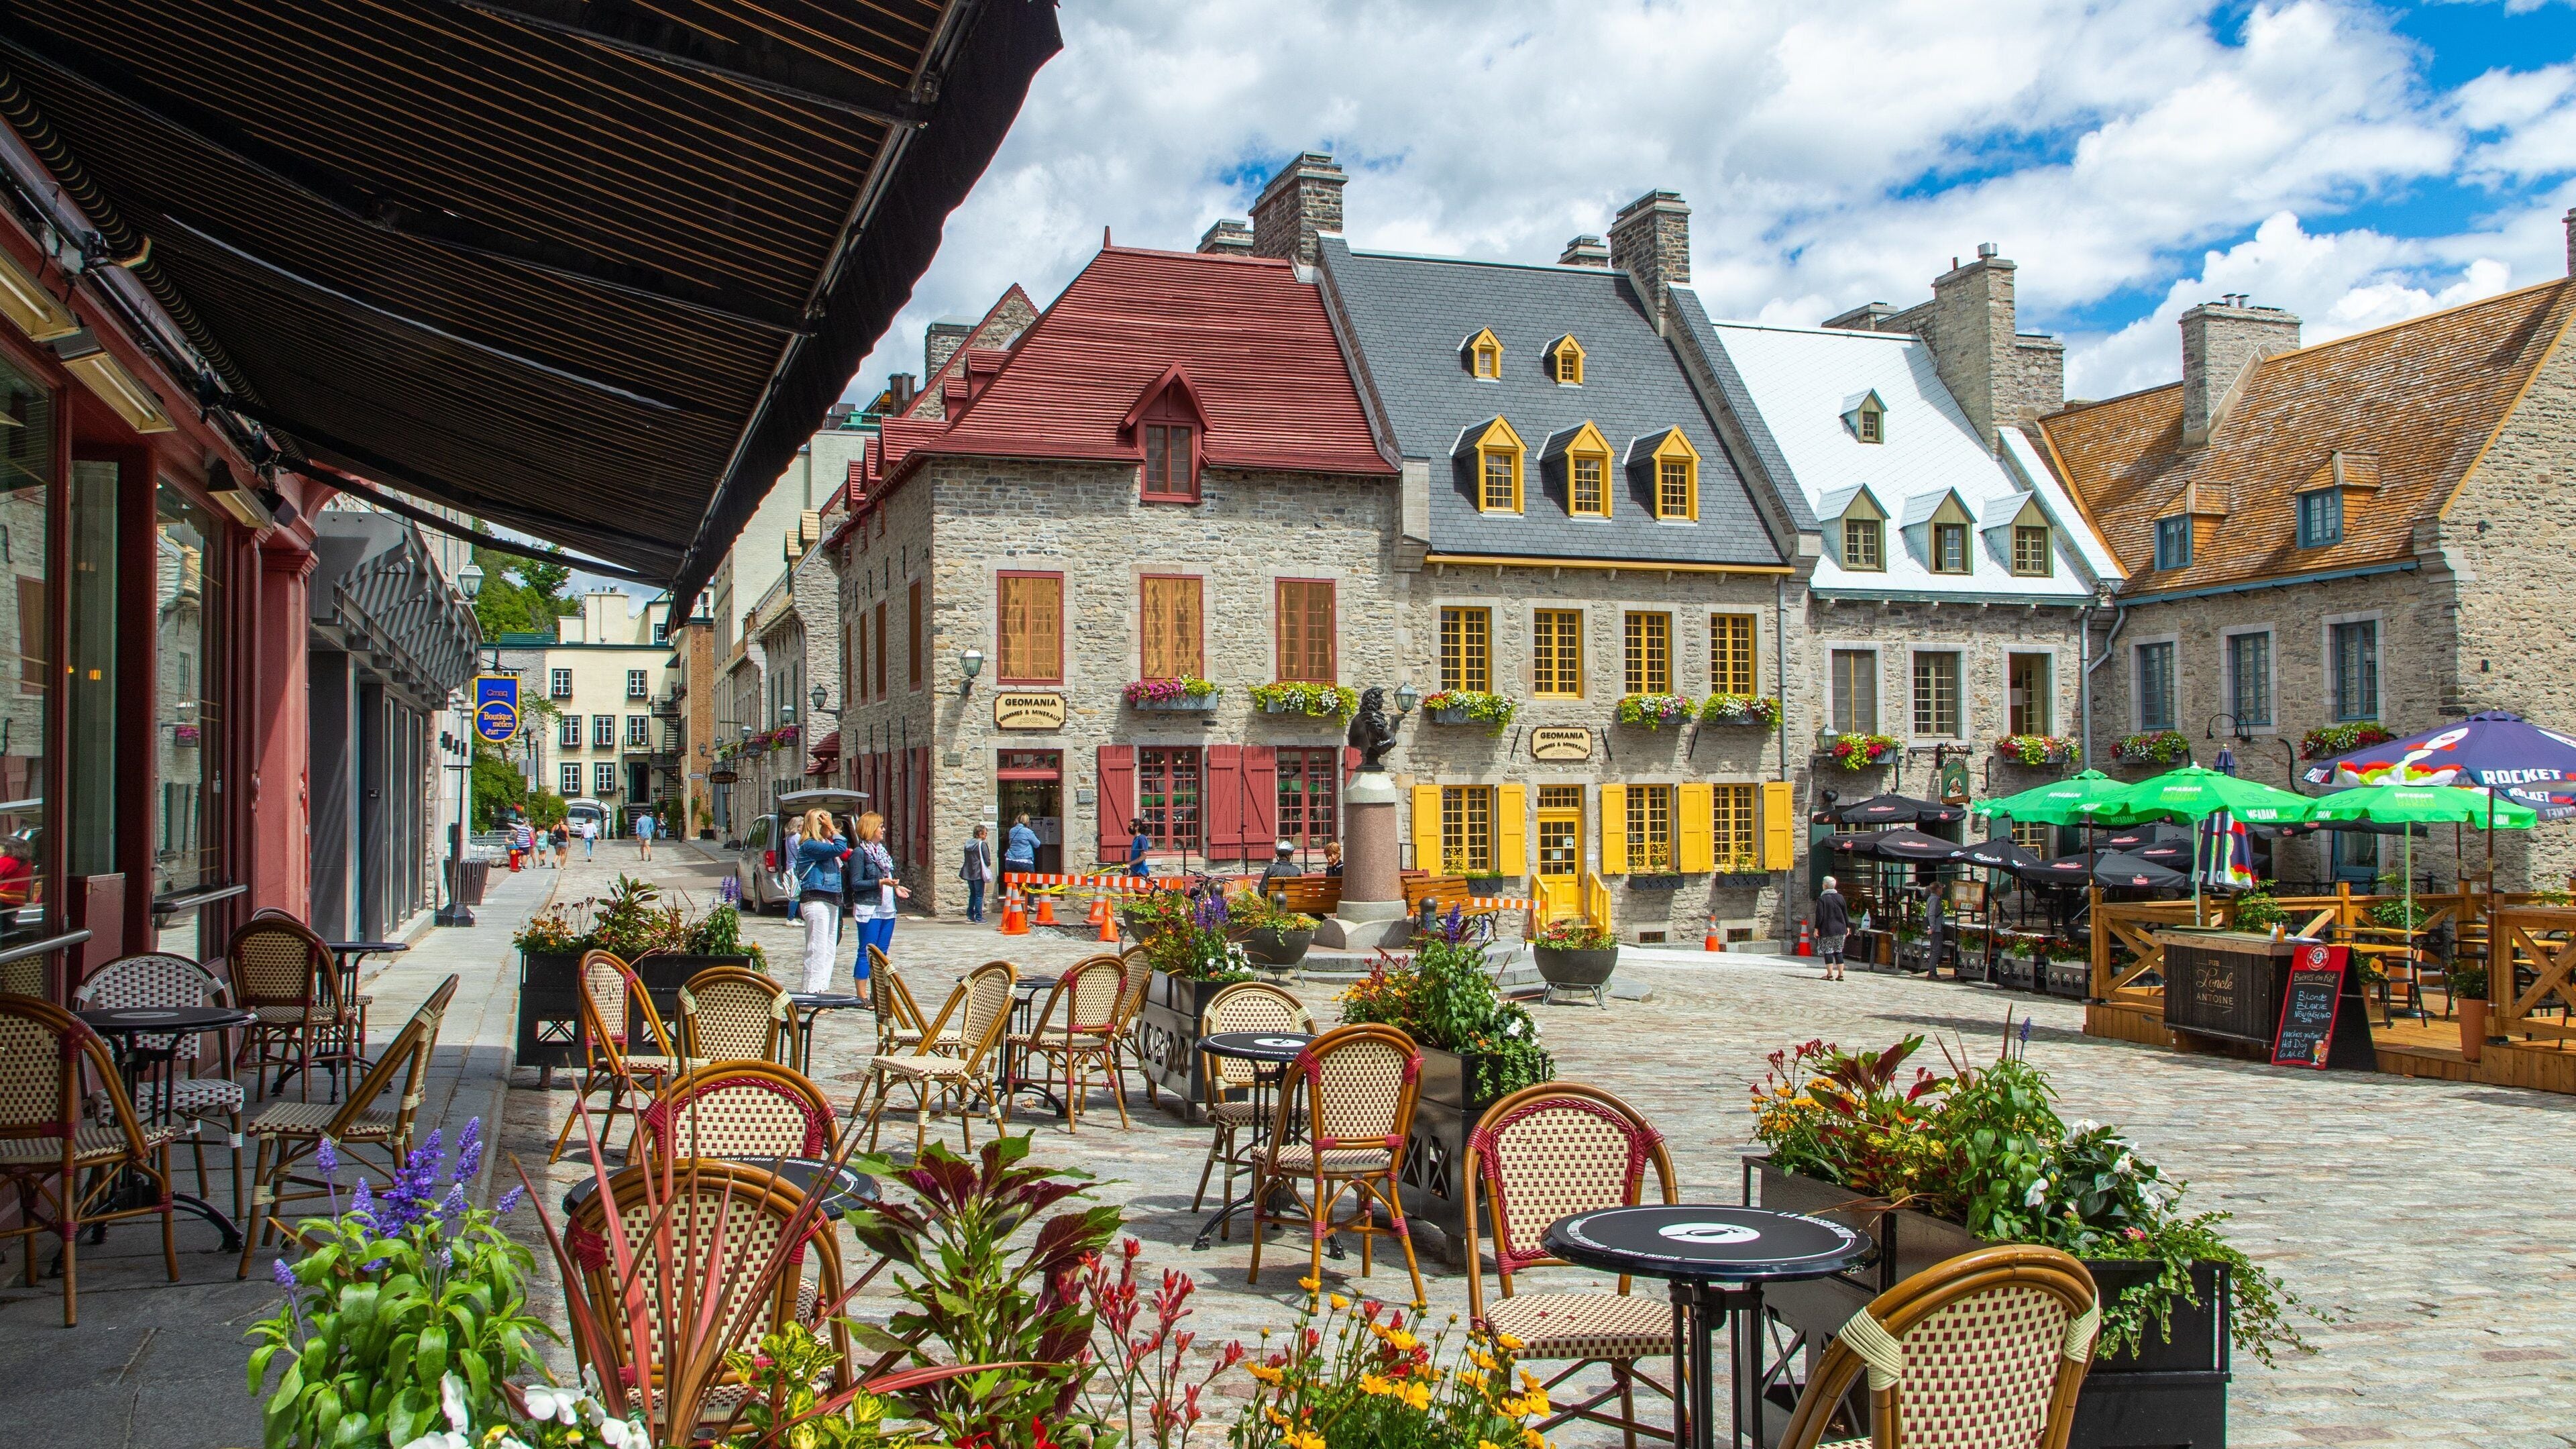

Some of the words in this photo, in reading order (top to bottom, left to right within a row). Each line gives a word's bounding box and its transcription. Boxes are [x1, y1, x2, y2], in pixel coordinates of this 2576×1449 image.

[1005, 698, 1057, 706] GEOMANIA
[482, 712, 513, 722] Boutique
[1000, 710, 1024, 722] GEMMES
[1536, 742, 1556, 753] GEMMES
[2480, 768, 2562, 785] ROCKET
[2196, 993, 2234, 1006] ANTOINE
[2282, 1038, 2293, 1049] Hot
[2293, 1039, 2308, 1053] Dog
[2279, 1049, 2286, 1058] 6
